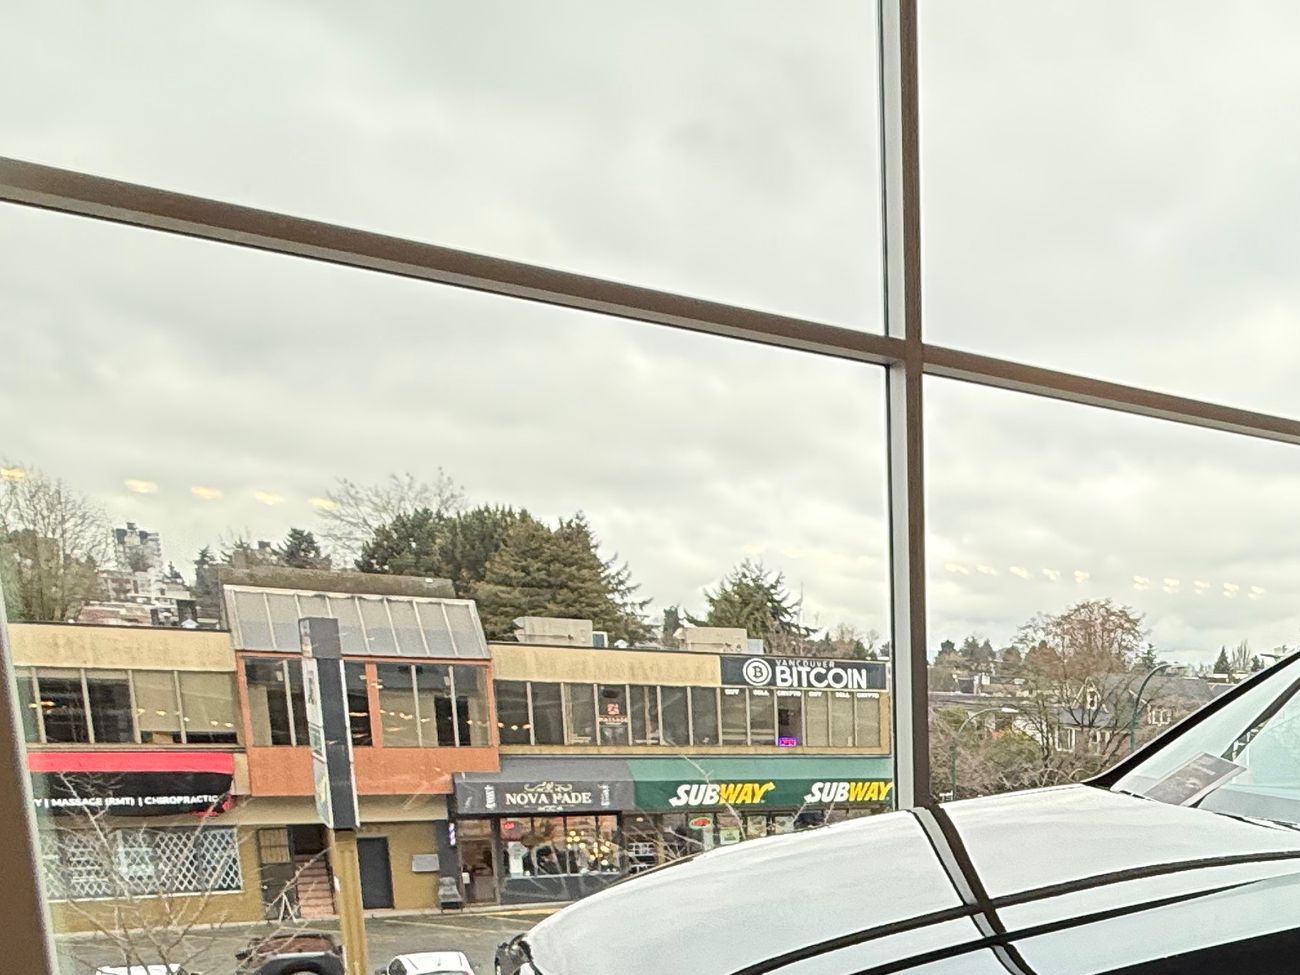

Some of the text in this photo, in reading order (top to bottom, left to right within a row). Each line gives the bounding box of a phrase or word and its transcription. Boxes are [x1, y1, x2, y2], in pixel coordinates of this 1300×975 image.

[775, 659, 835, 668] VANCOUVER
[775, 666, 867, 689] BITCOIN
[50, 797, 104, 807] MASSAGE
[144, 795, 219, 805] CHIROPRACTIC
[505, 792, 549, 805] NOVA
[552, 791, 593, 805] FADE
[669, 782, 776, 807] SUBWAY
[804, 782, 893, 803] SUBWAY
